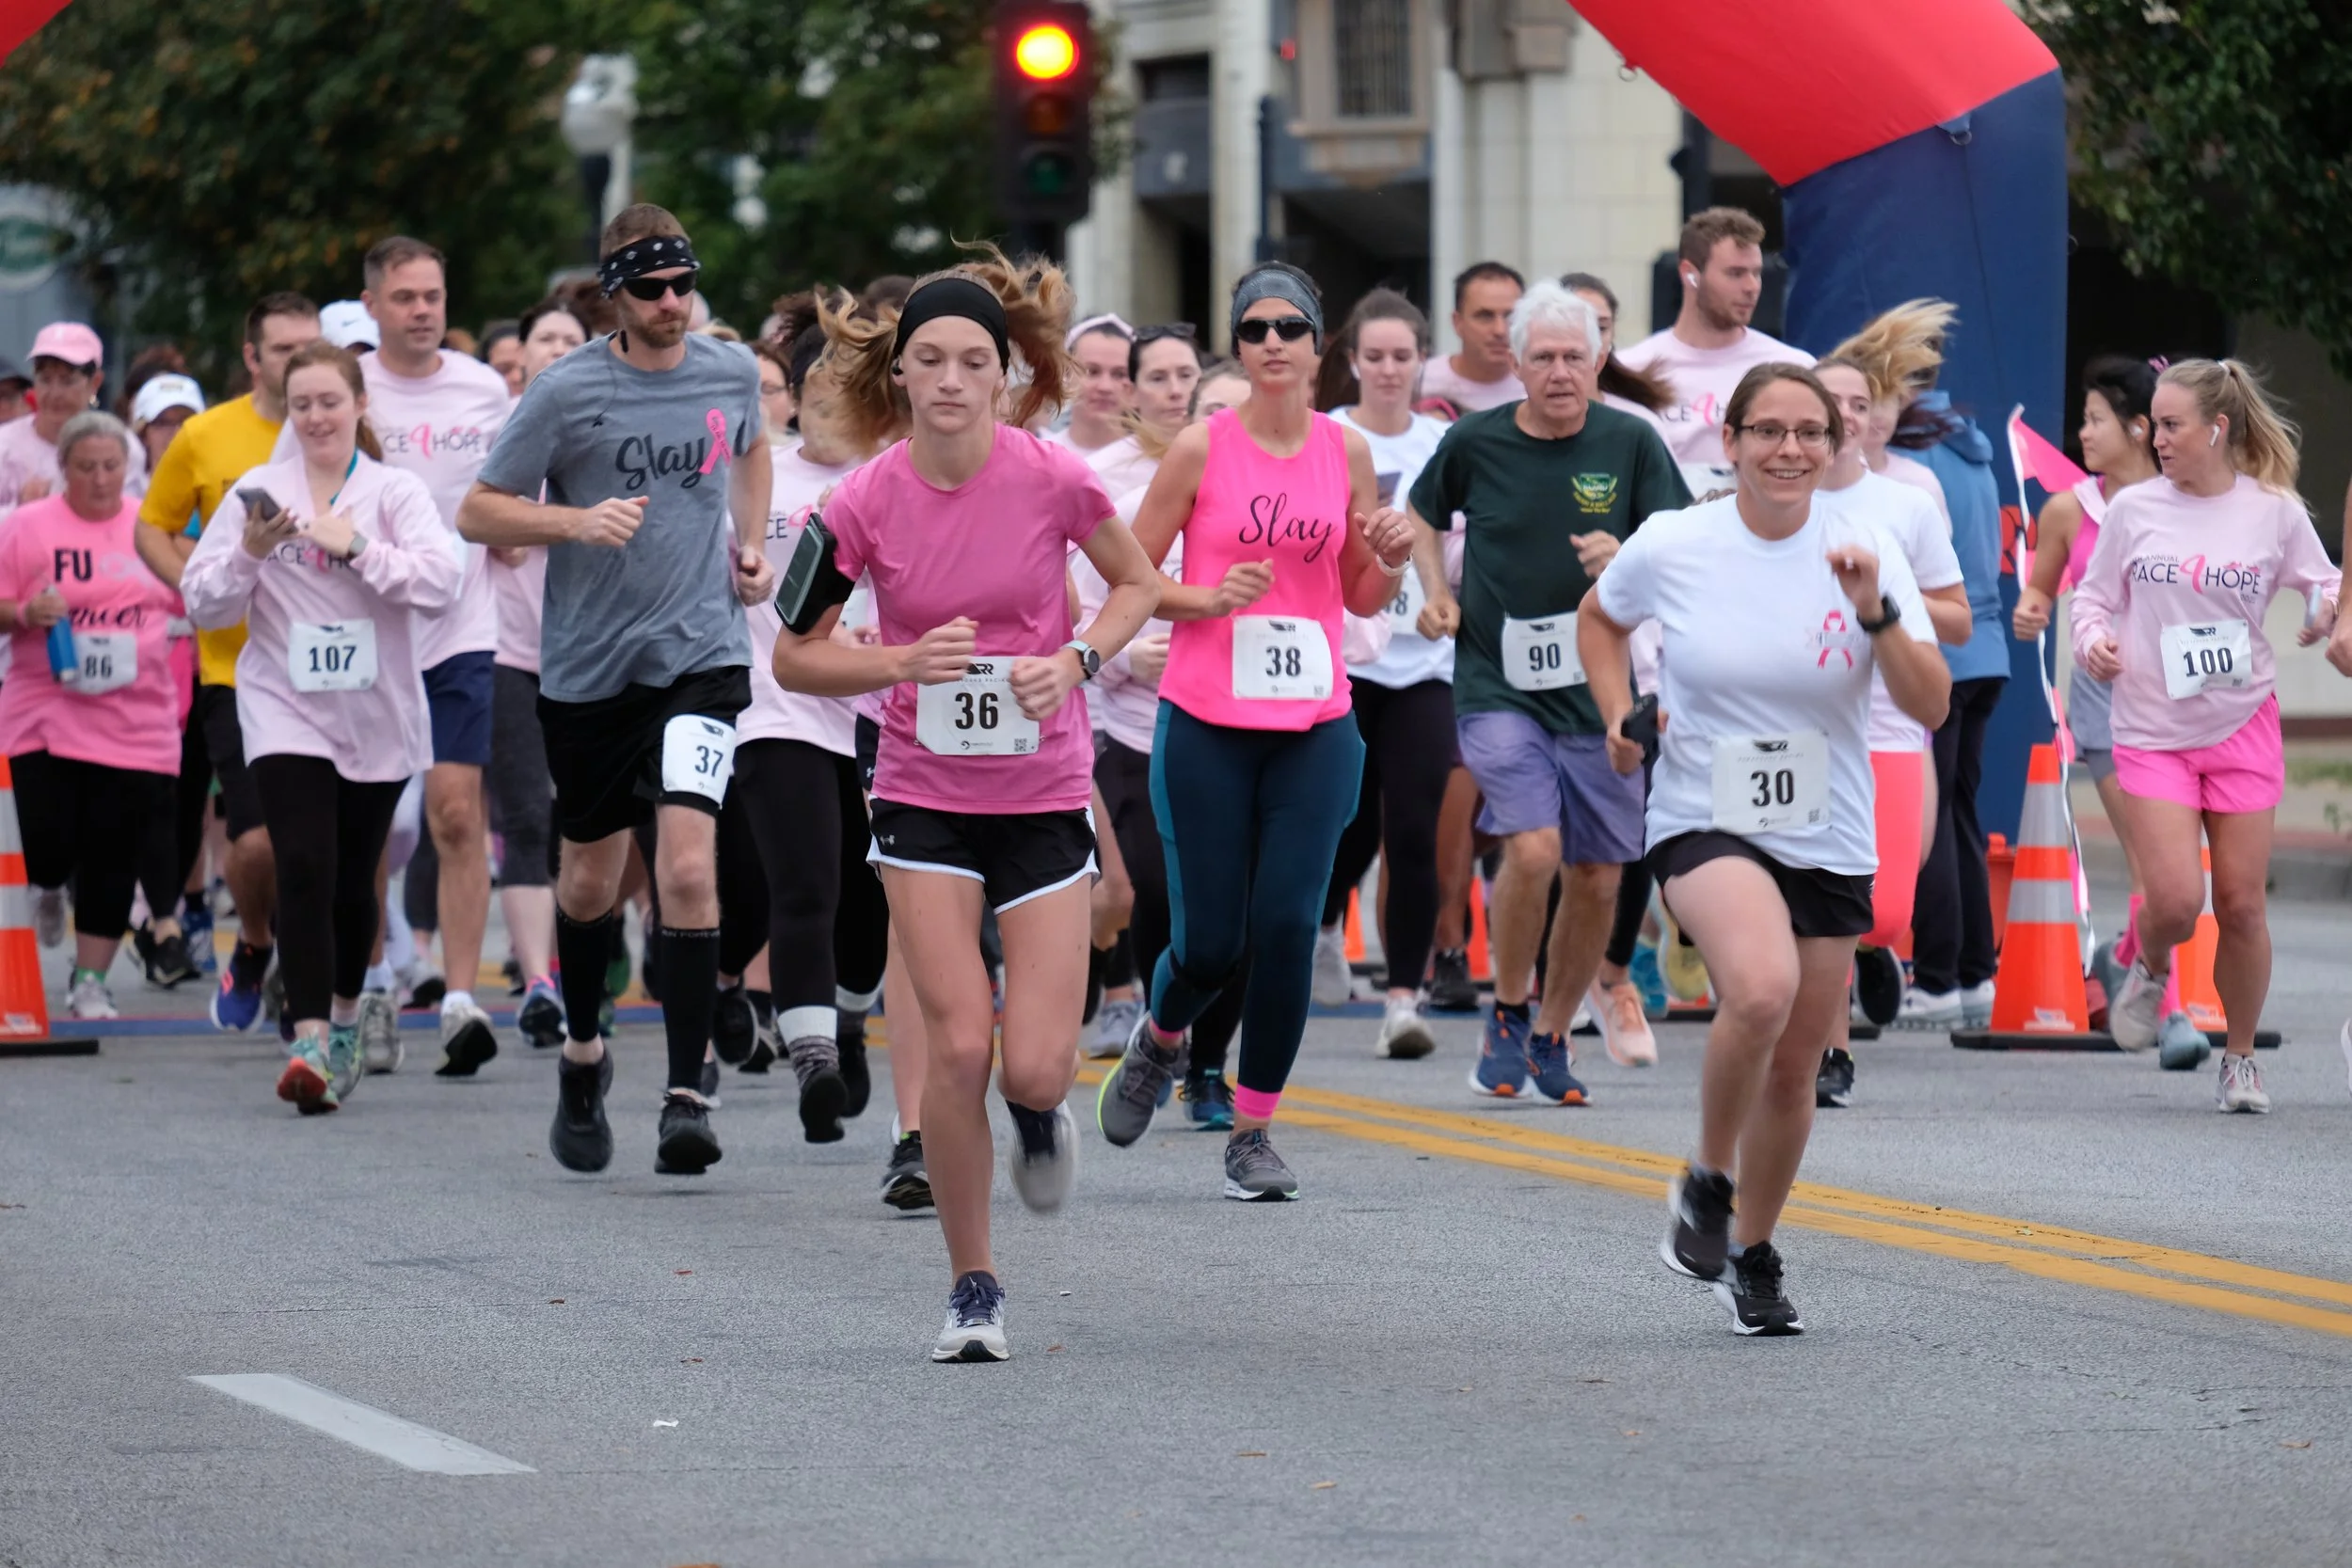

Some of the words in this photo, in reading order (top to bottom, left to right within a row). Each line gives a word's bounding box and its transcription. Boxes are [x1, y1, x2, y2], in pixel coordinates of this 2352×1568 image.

[615, 434, 706, 491] Slay
[1238, 492, 1338, 563] Slay
[54, 548, 92, 583] FU
[267, 543, 306, 566] ACE
[2204, 566, 2262, 595] HOPE
[85, 655, 113, 679] 86
[309, 645, 358, 673] 107
[1264, 645, 1301, 677] 38
[1529, 642, 1562, 673] 90
[2183, 647, 2233, 678] 100
[954, 691, 999, 731] 36
[694, 744, 724, 779] 37
[1750, 768, 1795, 807] 30
